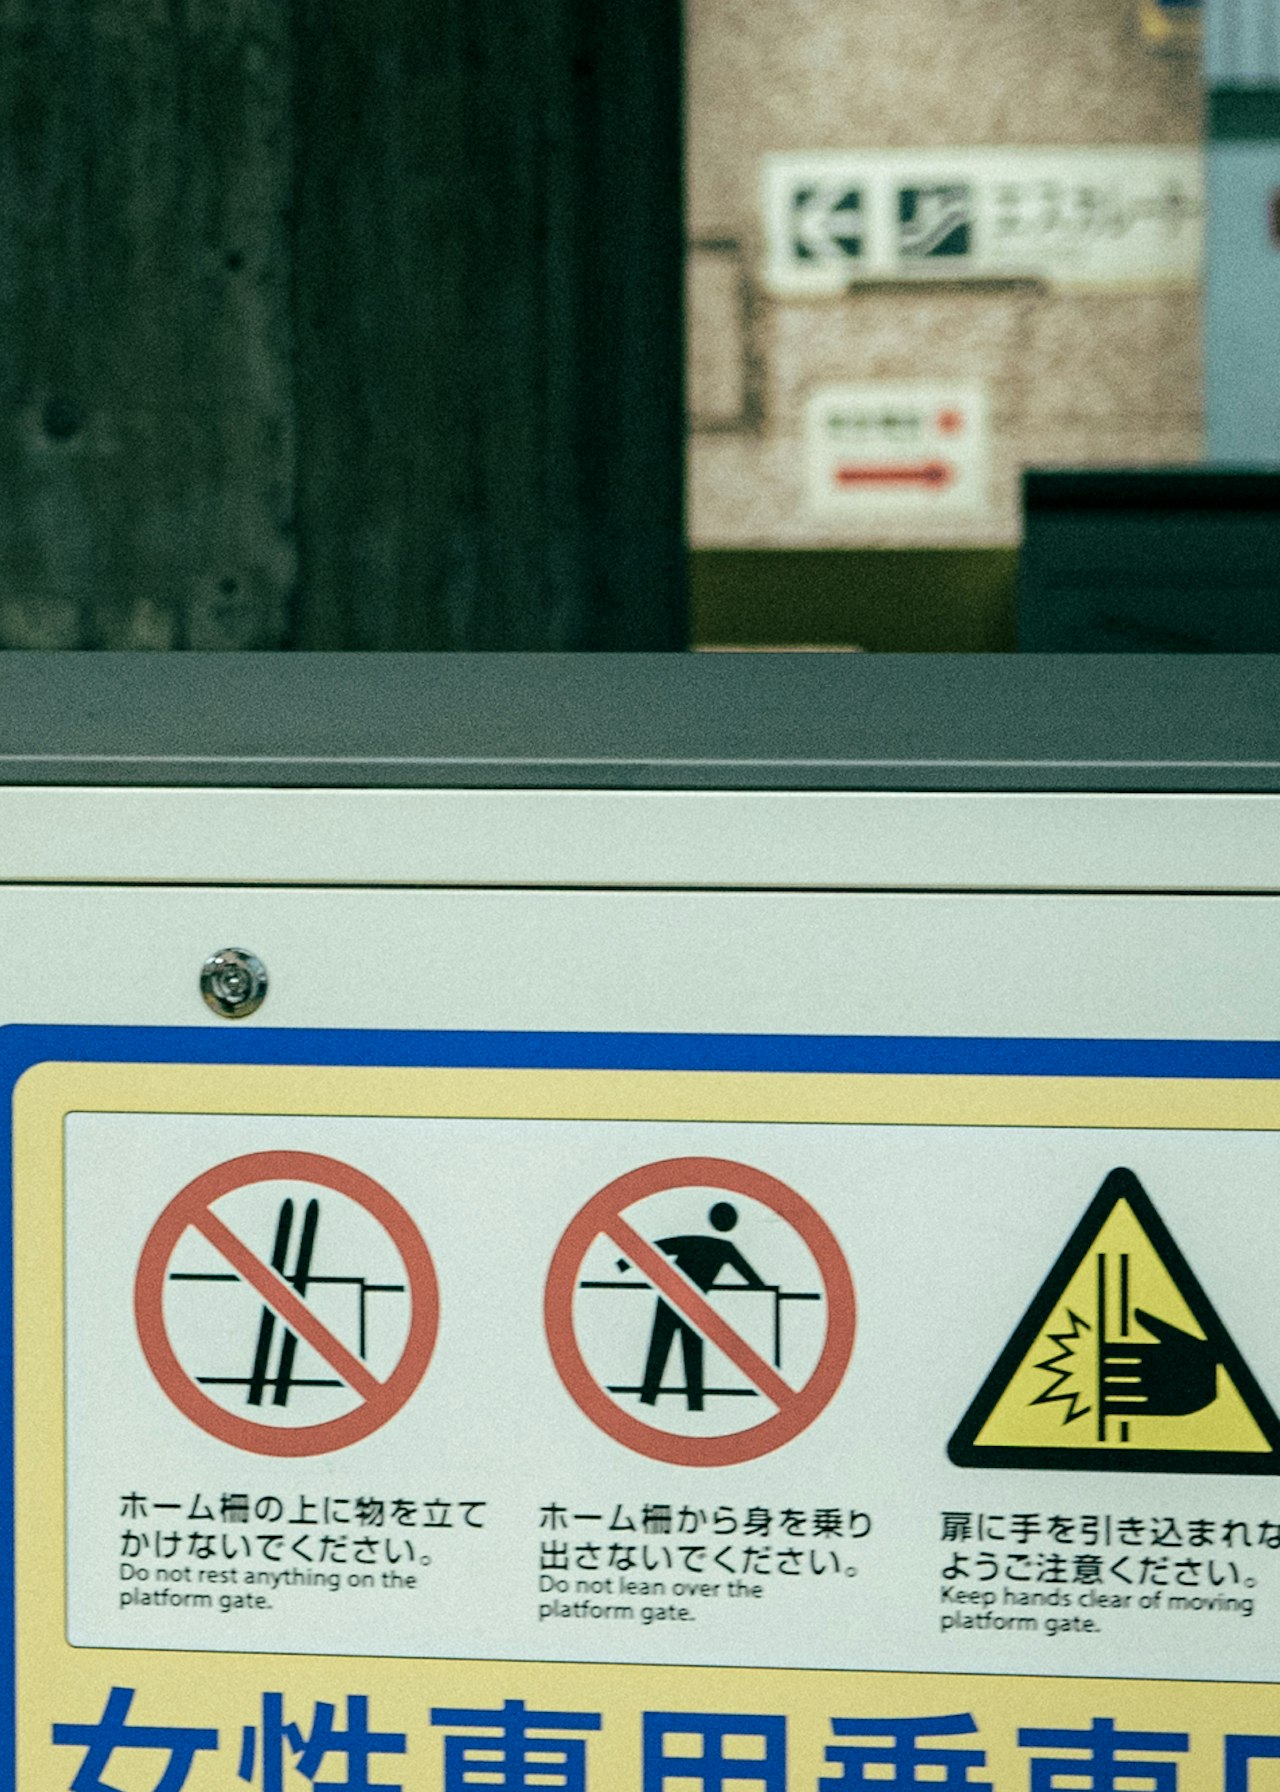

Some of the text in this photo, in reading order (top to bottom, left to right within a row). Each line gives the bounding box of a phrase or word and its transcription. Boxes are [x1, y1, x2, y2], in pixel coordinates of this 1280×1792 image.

[120, 1491, 488, 1529] ホーム柵の上に物を立て
[539, 1501, 873, 1539] ホーム柵から身を乗り
[120, 1529, 432, 1567] かけないでください。
[539, 1539, 858, 1579] 出さないでください。
[119, 1562, 418, 1592] Do not rest anything on the
[538, 1574, 764, 1599] Do not lean over the
[941, 1551, 1258, 1589] ようご注意ください。
[119, 1587, 273, 1614] platform gate.
[538, 1599, 695, 1626] platform gate.
[940, 1585, 1255, 1618] Keep hands clear of moving
[940, 1610, 1101, 1637] platform gate.
